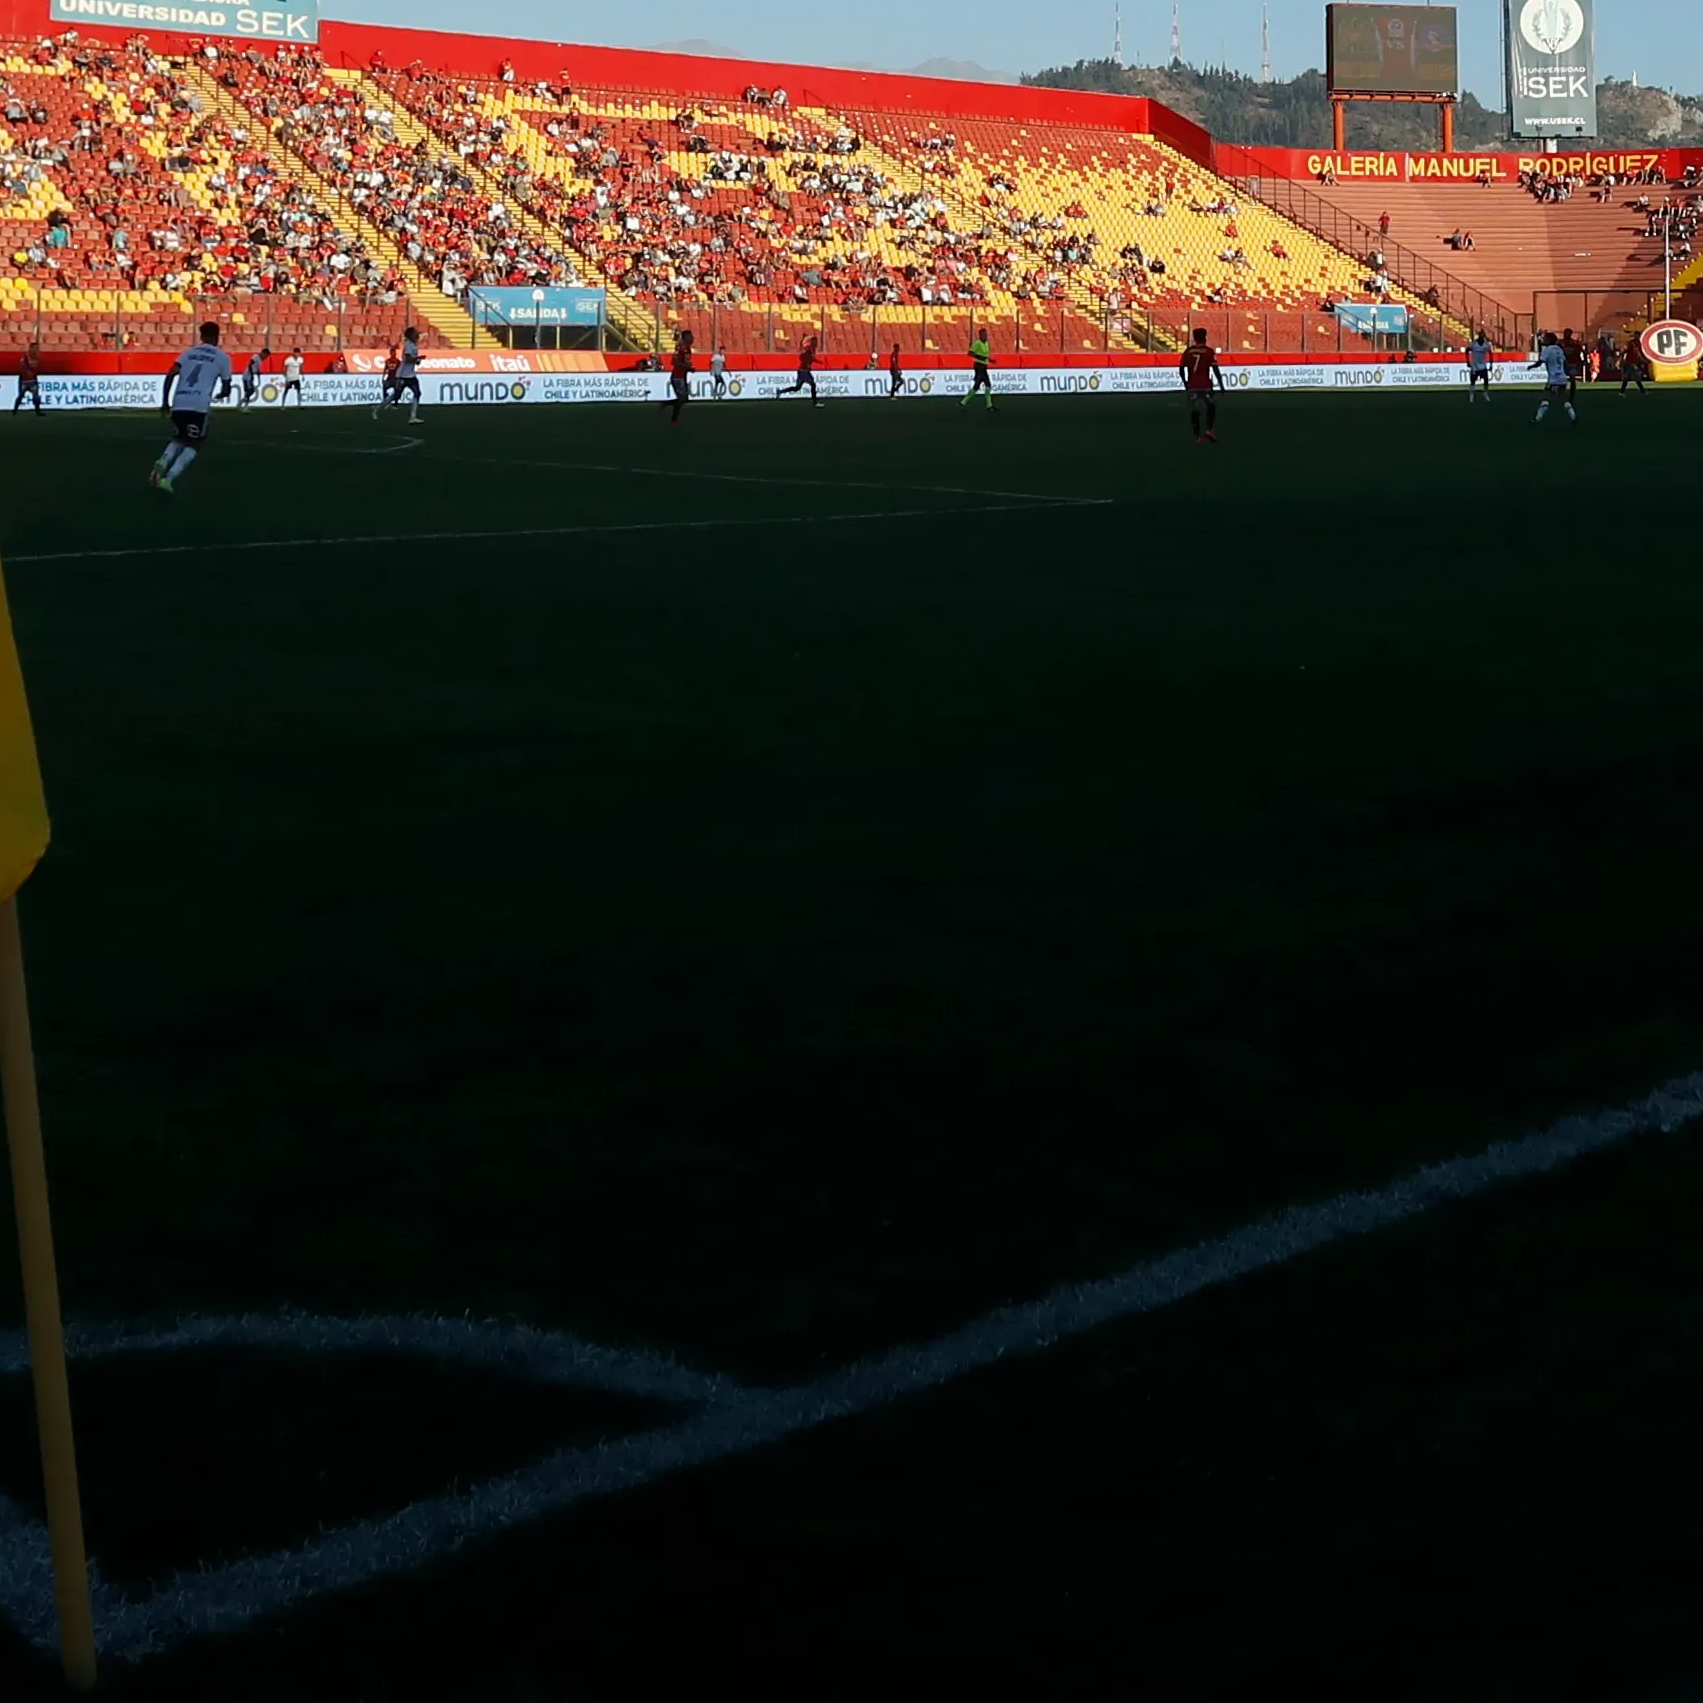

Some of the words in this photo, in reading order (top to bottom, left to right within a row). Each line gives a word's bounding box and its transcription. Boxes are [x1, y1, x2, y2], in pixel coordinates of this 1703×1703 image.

[235, 9, 310, 38] SEK
[1527, 66, 1586, 74] UNIVERSIDAD
[1528, 76, 1589, 98] SEK
[1308, 152, 1398, 177] GALERÍA
[1408, 156, 1507, 177] MANUEL
[1518, 152, 1659, 177] RODRÍGUEZ
[1657, 329, 1689, 354] PF
[374, 356, 476, 372] Cpeonato
[489, 354, 531, 372] itaú
[1192, 354, 1201, 373] 7
[71, 379, 95, 392] MÁS
[98, 379, 140, 392] RÁPIDA
[142, 381, 157, 391] DE
[313, 380, 342, 390] FIBRA
[345, 377, 366, 390] MÁS
[543, 379, 553, 388] LA
[556, 378, 582, 387] FIBRA
[584, 376, 602, 387] MÁS
[638, 377, 649, 386] DE
[20, 395, 51, 405] CHLE
[55, 395, 64, 405] Y
[65, 393, 156, 405] LATINOAMÉRICA
[301, 393, 329, 402] CHILE
[331, 393, 338, 402] Y
[544, 390, 570, 399] CHILE
[572, 390, 578, 398] Y
